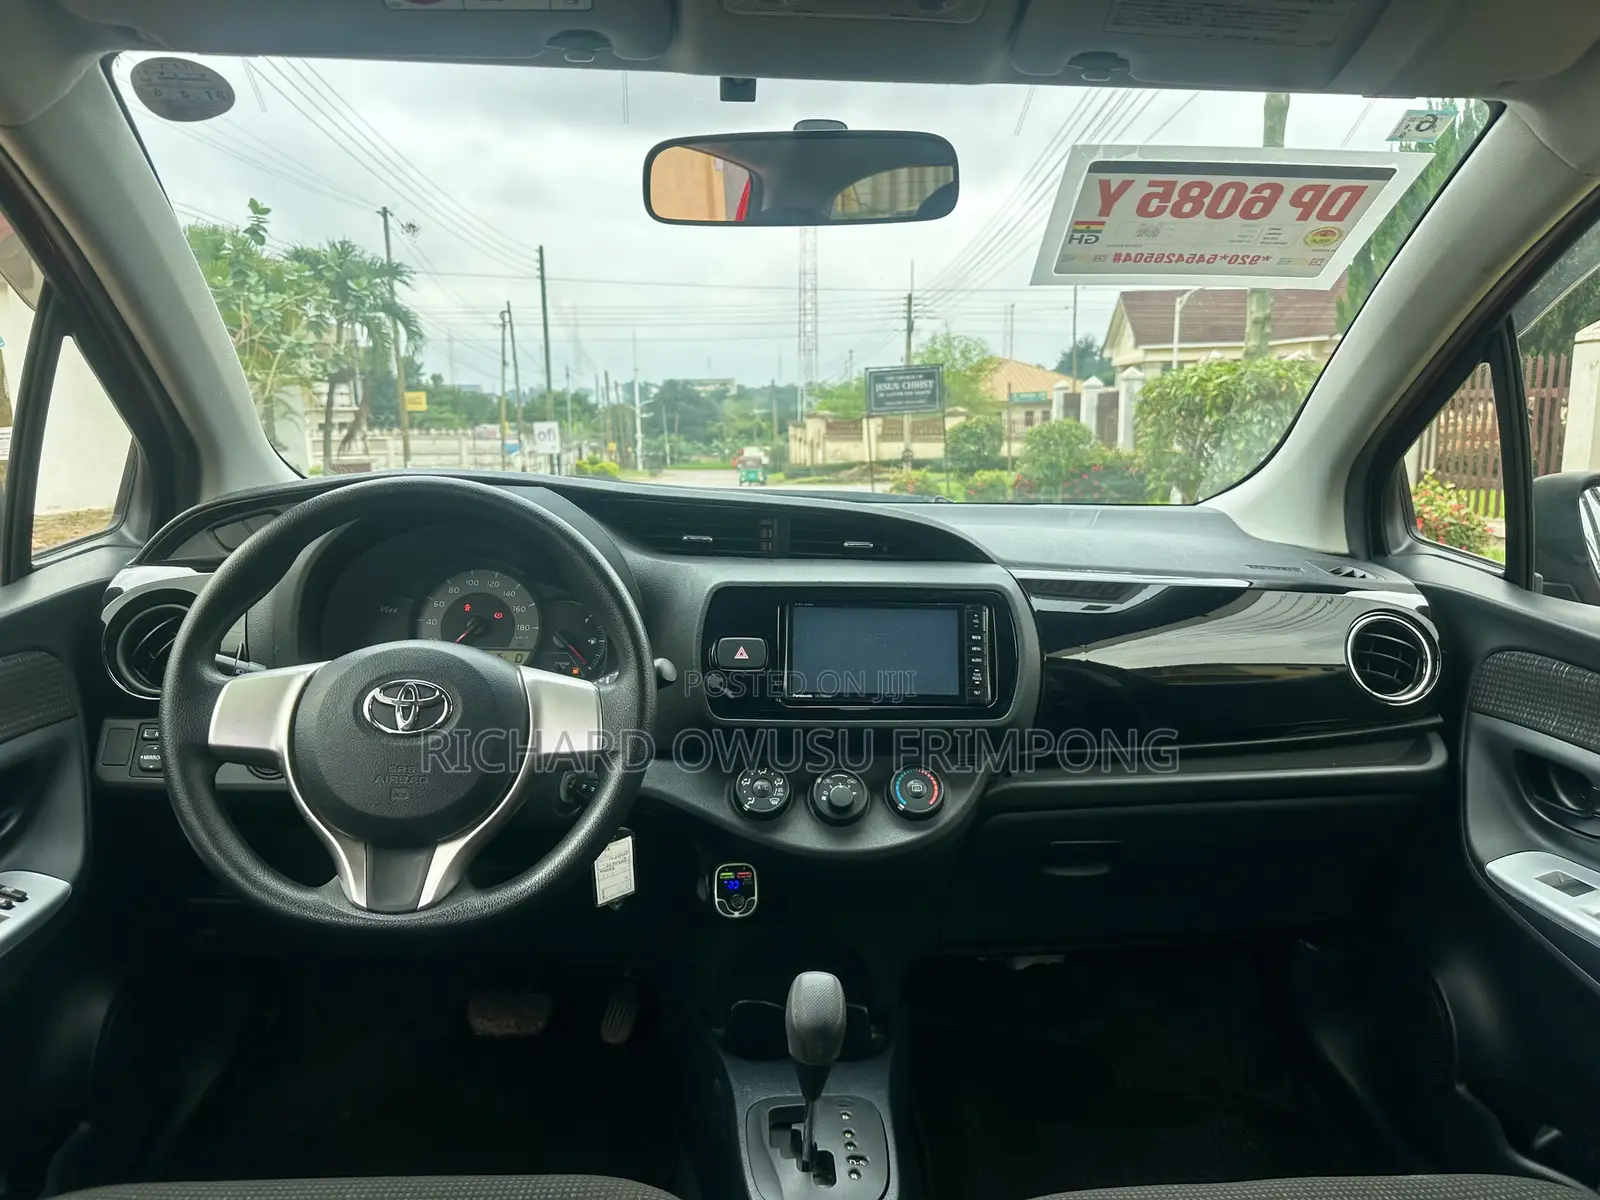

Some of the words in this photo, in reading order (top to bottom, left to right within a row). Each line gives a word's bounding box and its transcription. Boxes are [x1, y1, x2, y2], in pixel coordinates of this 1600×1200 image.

[465, 579, 479, 587] 100
[486, 580, 500, 588] 120
[448, 586, 460, 594] 80
[503, 590, 516, 598] 140
[433, 600, 445, 608] 60
[513, 605, 526, 613] 160
[426, 618, 438, 626] 40
[516, 624, 531, 632] 180
